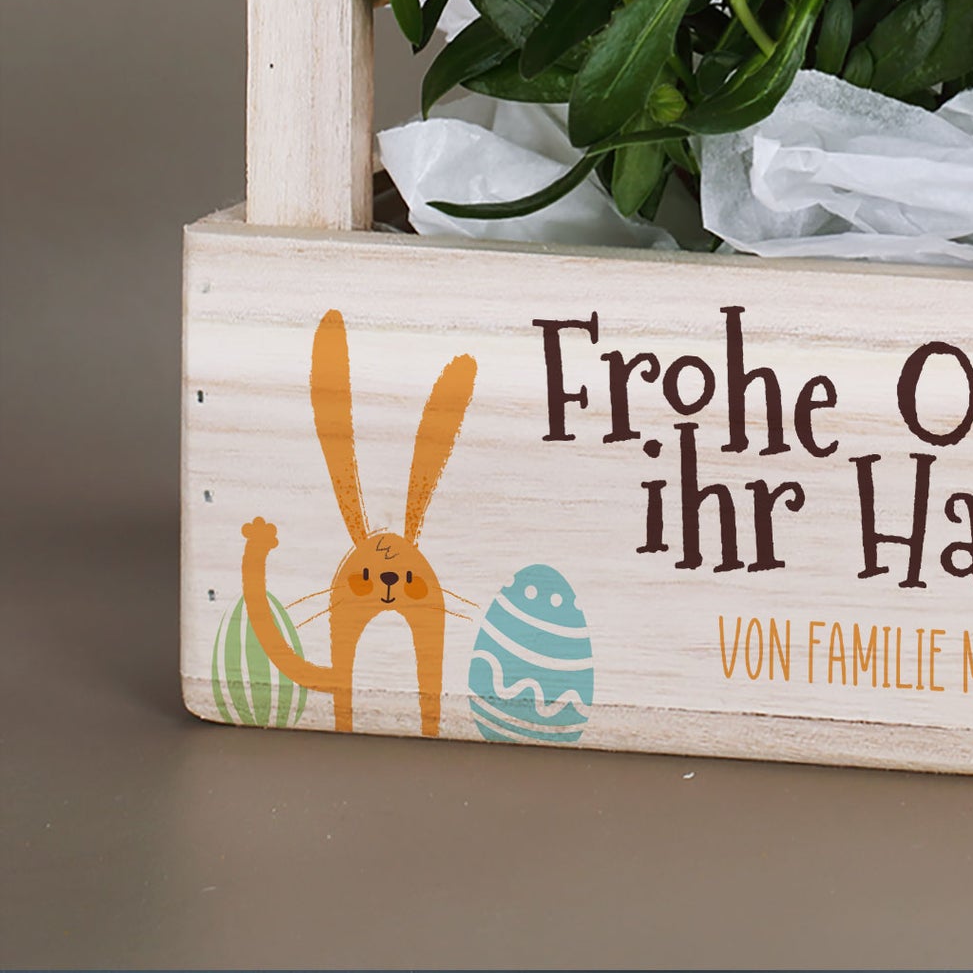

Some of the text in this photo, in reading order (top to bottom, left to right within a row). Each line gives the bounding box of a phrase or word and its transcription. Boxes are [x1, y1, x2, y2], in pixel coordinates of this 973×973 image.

[532, 306, 840, 457] Frohe
[636, 422, 805, 573] ihr
[718, 616, 790, 682] VON
[809, 621, 946, 693] FAMILIE
